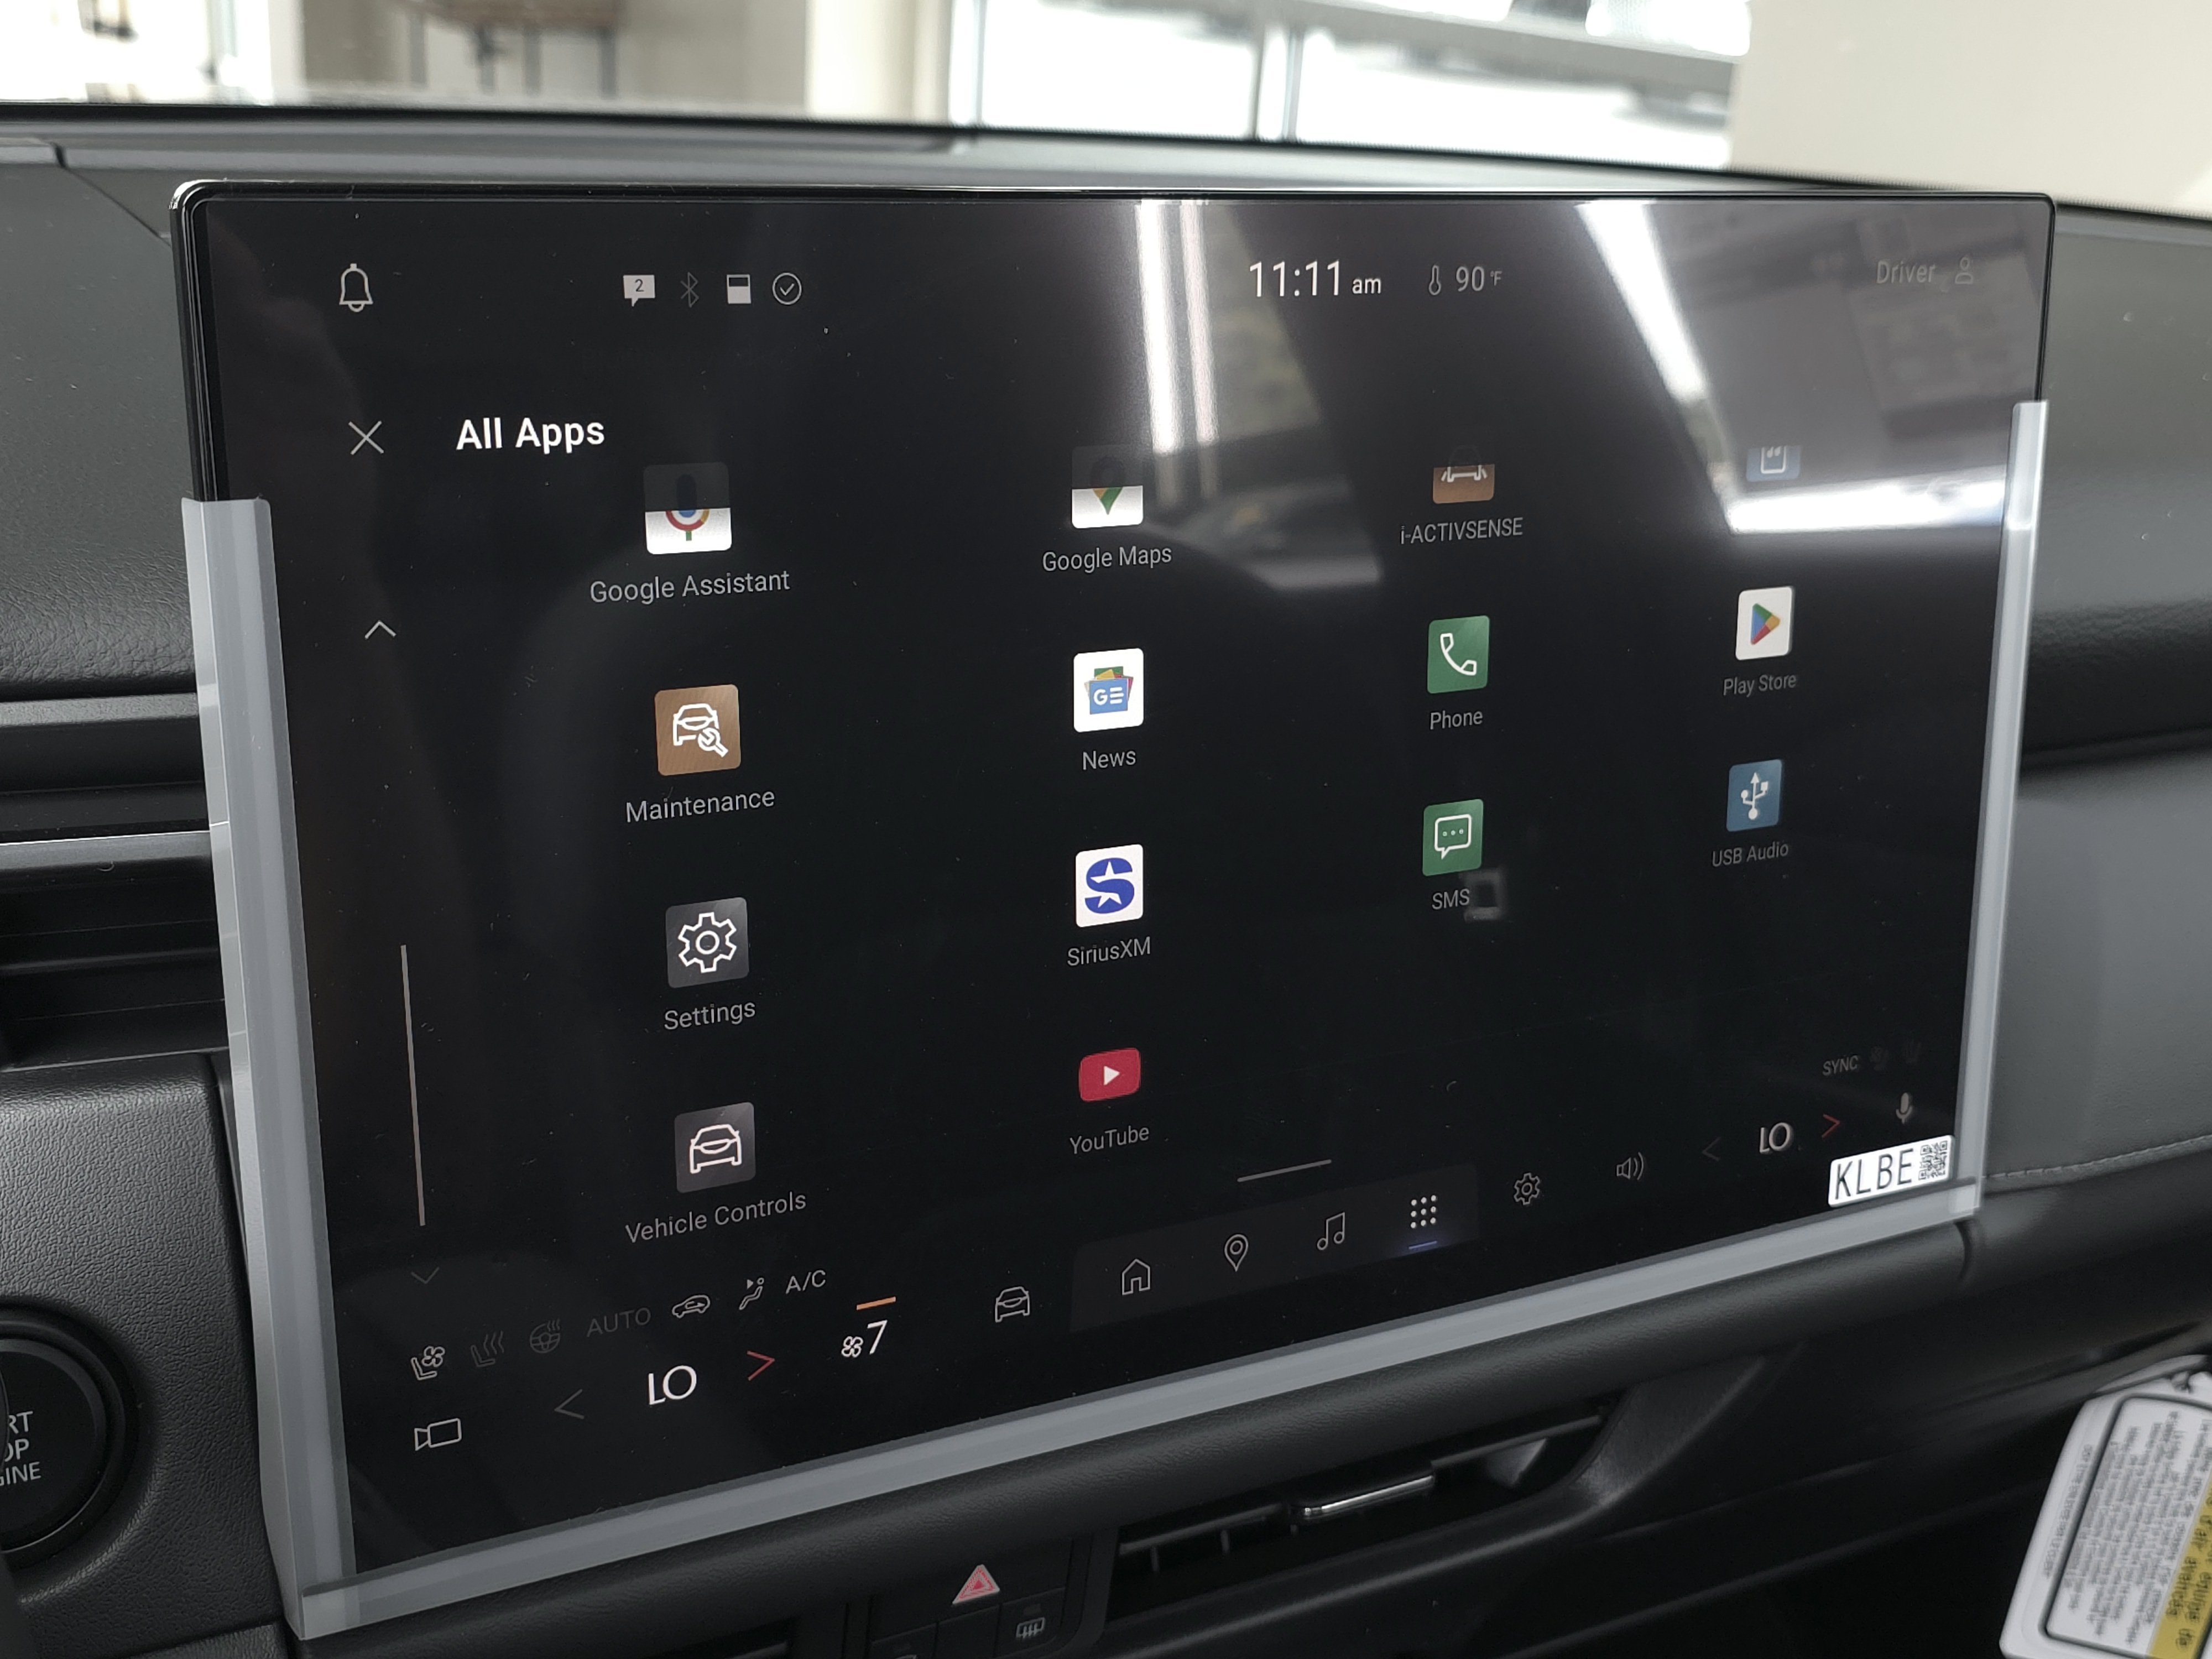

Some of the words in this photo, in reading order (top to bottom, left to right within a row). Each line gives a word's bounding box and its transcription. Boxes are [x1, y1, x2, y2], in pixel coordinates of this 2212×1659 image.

[635, 279, 644, 292] 2
[1249, 260, 1339, 298] 11:11
[1352, 278, 1381, 294] am
[1456, 266, 1485, 291] 90
[1877, 260, 1937, 285] Driver
[456, 417, 503, 450] All
[515, 417, 604, 455] Apps
[1401, 517, 1523, 545] i-ACTIVSENSE
[1043, 547, 1113, 573] Google
[1119, 545, 1172, 568] Maps
[590, 576, 675, 605] Google
[682, 570, 790, 597] Assistant
[1723, 677, 1755, 697] Play
[1758, 674, 1797, 691] Store
[1430, 710, 1483, 730] Phone
[1083, 750, 1136, 770] News
[626, 791, 775, 823] Maintenance
[1712, 848, 1743, 867] USB
[1746, 841, 1789, 862] Audio
[1432, 888, 1470, 910] SMS
[1067, 936, 1150, 966] SiriusXM
[664, 1002, 755, 1030] Settings
[1822, 1055, 1859, 1076] SYNC
[1070, 1125, 1149, 1154] YouTube
[1759, 1122, 1791, 1154] LO
[1834, 1148, 1914, 1200] KLBE
[625, 1211, 707, 1243] Vehicle
[714, 1191, 806, 1225] Controls
[785, 1270, 826, 1294] A/C
[587, 1307, 651, 1338] AUTO
[867, 1319, 888, 1354] 7
[648, 1365, 697, 1405] LO
